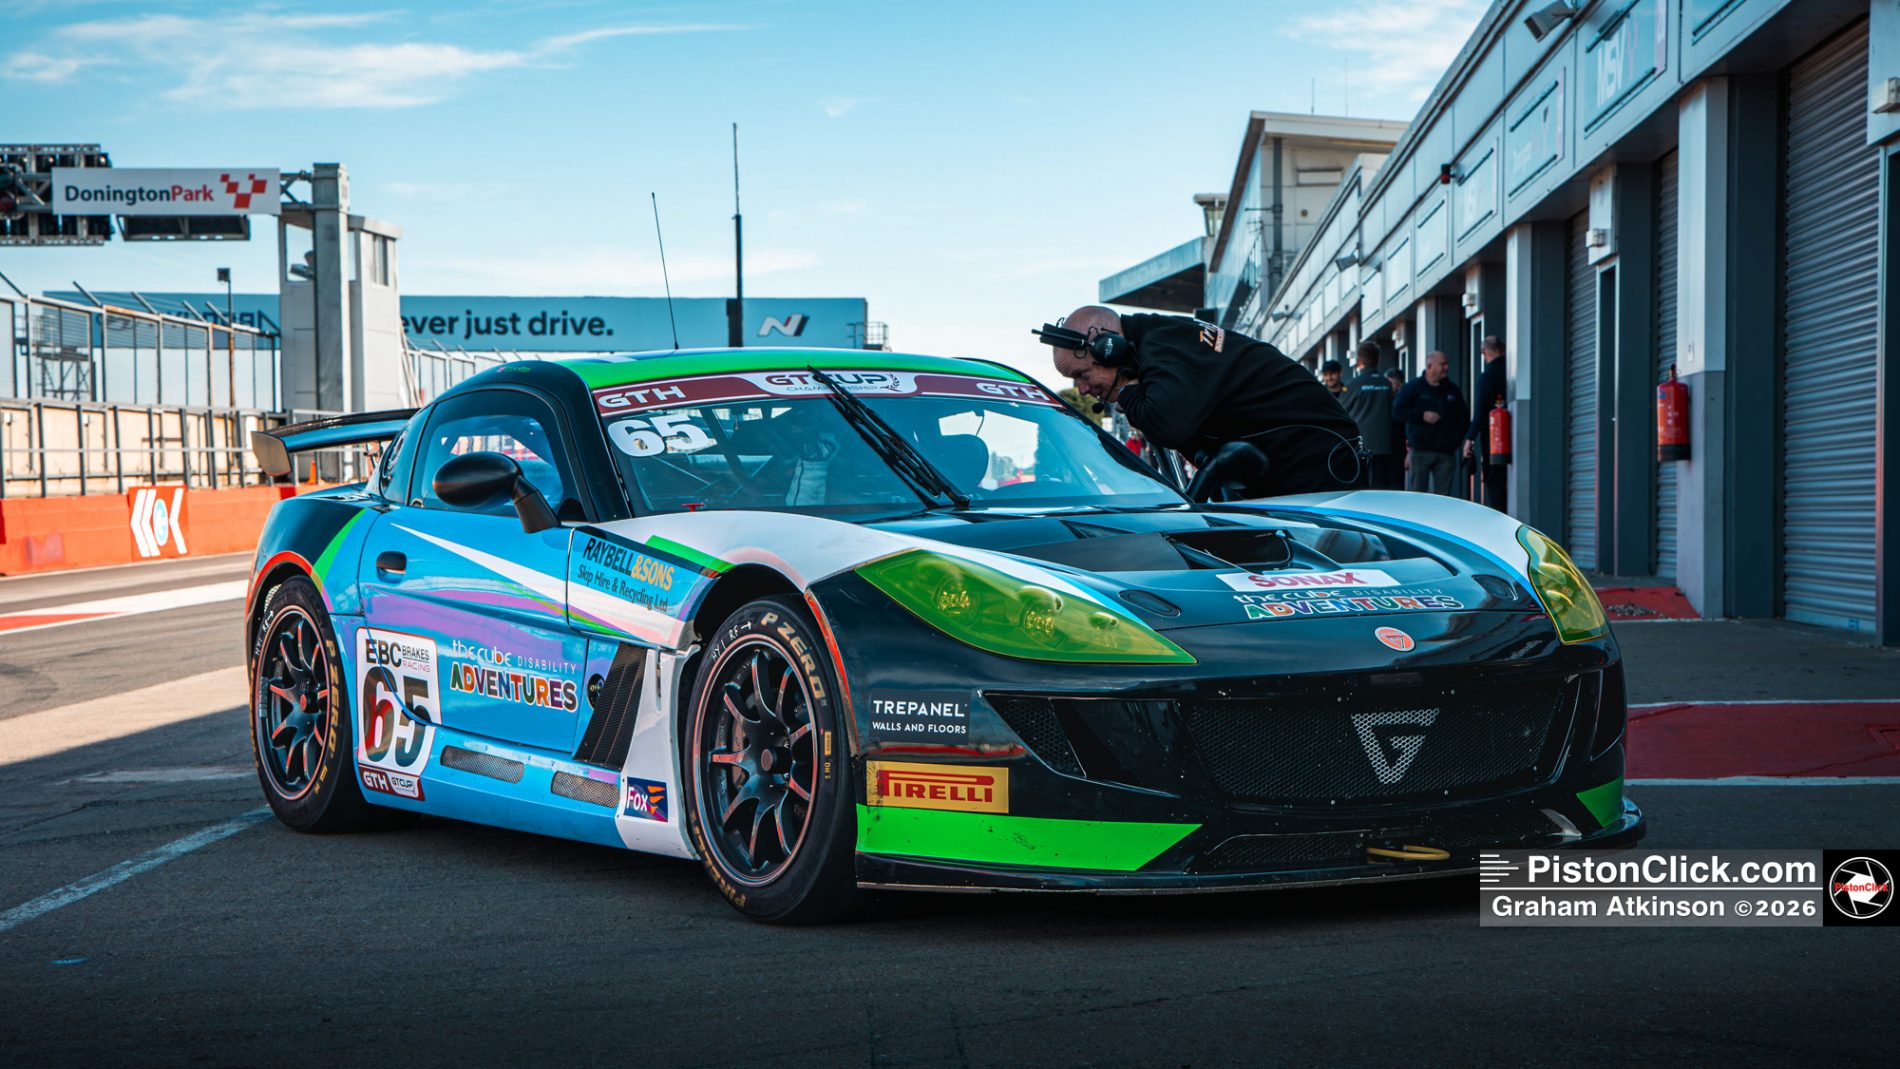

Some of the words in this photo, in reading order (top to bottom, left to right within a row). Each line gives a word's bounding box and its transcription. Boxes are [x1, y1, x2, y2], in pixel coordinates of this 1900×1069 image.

[464, 309, 521, 340] just
[528, 310, 614, 336] drive.
[598, 385, 686, 408] GTH
[976, 382, 1050, 401] GTH
[607, 413, 709, 457] 65
[578, 564, 593, 587] Skip
[594, 569, 611, 589] Hire
[612, 577, 618, 593] &
[619, 580, 653, 611] Recycling
[654, 594, 669, 612] Ltd
[1248, 572, 1367, 588] SONAX
[1233, 592, 1276, 605] the
[1282, 590, 1343, 601] cube
[1353, 588, 1443, 596] DISABILITY
[1243, 595, 1464, 620] ADVENTURES
[365, 638, 402, 668] EBC
[402, 645, 430, 661] BRAKES
[402, 660, 431, 673] RACING
[452, 639, 475, 660] the
[477, 646, 512, 667] cube
[518, 655, 577, 675] DISABILITY
[761, 612, 779, 626] P
[777, 622, 826, 700] ZERO
[450, 661, 578, 713] ADVENTURES
[363, 665, 432, 768] 65
[873, 700, 965, 717] TREPANEL
[872, 721, 902, 731] WALLS
[904, 723, 925, 733] AND
[928, 723, 967, 734] FLOORS
[364, 770, 390, 791] GTH
[877, 769, 995, 803] PIRELLI
